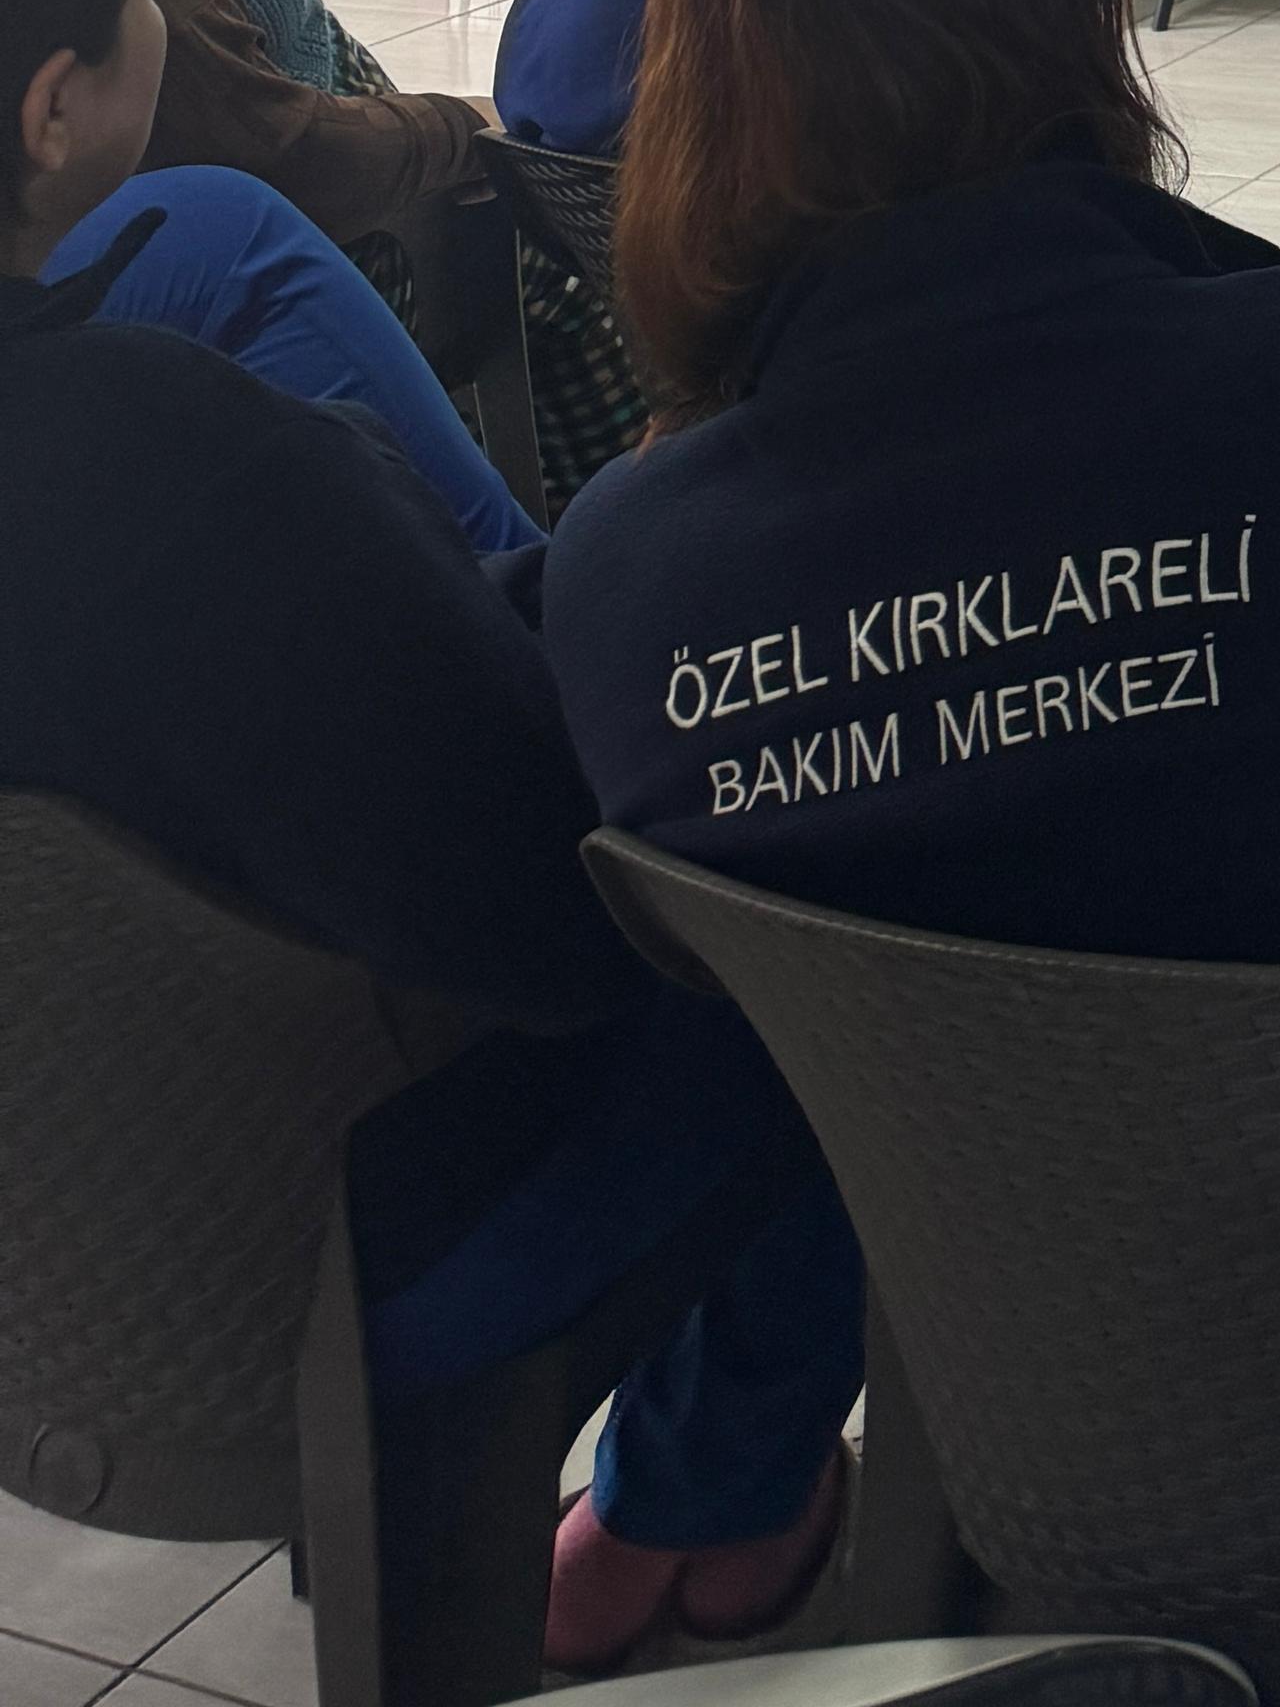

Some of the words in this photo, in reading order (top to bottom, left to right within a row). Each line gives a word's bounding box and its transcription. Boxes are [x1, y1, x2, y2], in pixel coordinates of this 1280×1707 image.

[665, 623, 829, 730] ÖZEL
[848, 513, 1256, 683] KIRKLARELİ
[708, 712, 900, 815] BAKIM
[936, 630, 1221, 766] MERKEZİ
